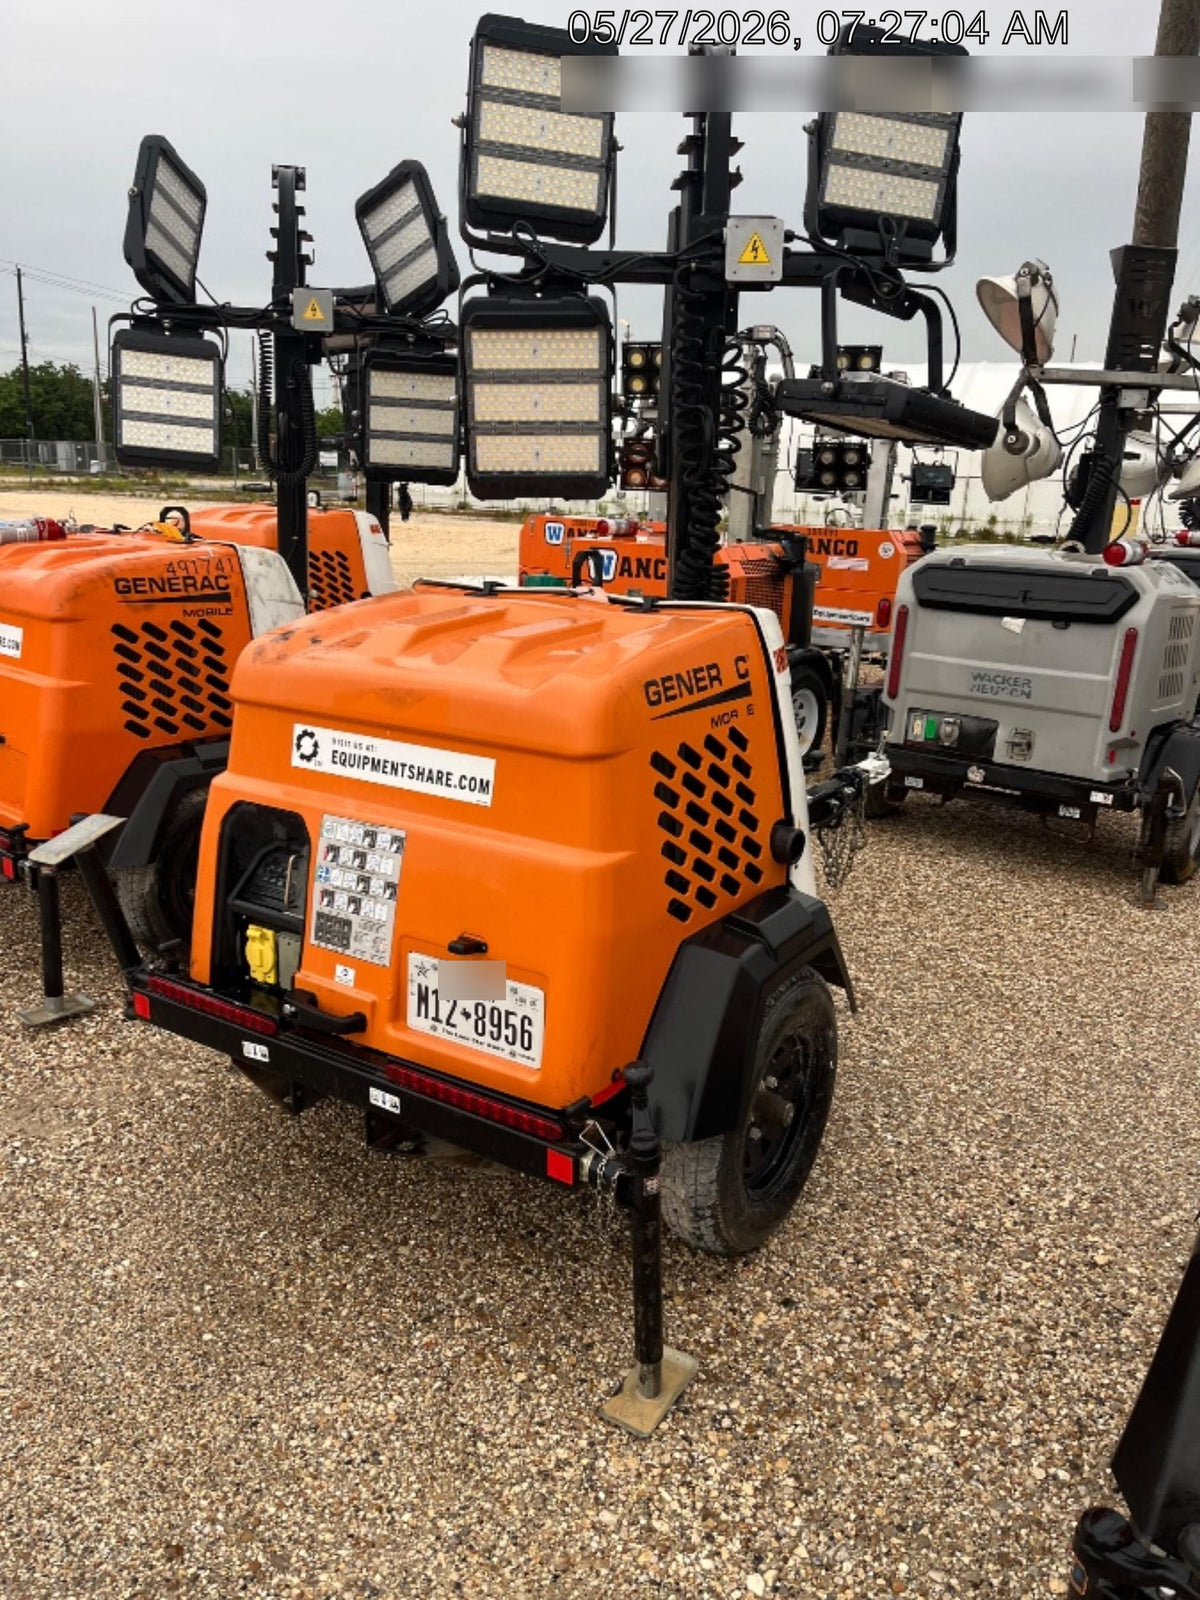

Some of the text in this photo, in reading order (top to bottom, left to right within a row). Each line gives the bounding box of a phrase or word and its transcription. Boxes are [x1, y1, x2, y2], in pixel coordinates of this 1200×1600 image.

[166, 557, 235, 577] 491741
[114, 574, 230, 595] GENERAC
[182, 606, 233, 618] MOBILE
[970, 671, 1032, 689] WACKER
[332, 737, 351, 748] VISIT
[353, 742, 363, 751] US
[331, 749, 490, 795] EQUIPMENTSHARE.COM
[474, 1002, 533, 1052] 8956
